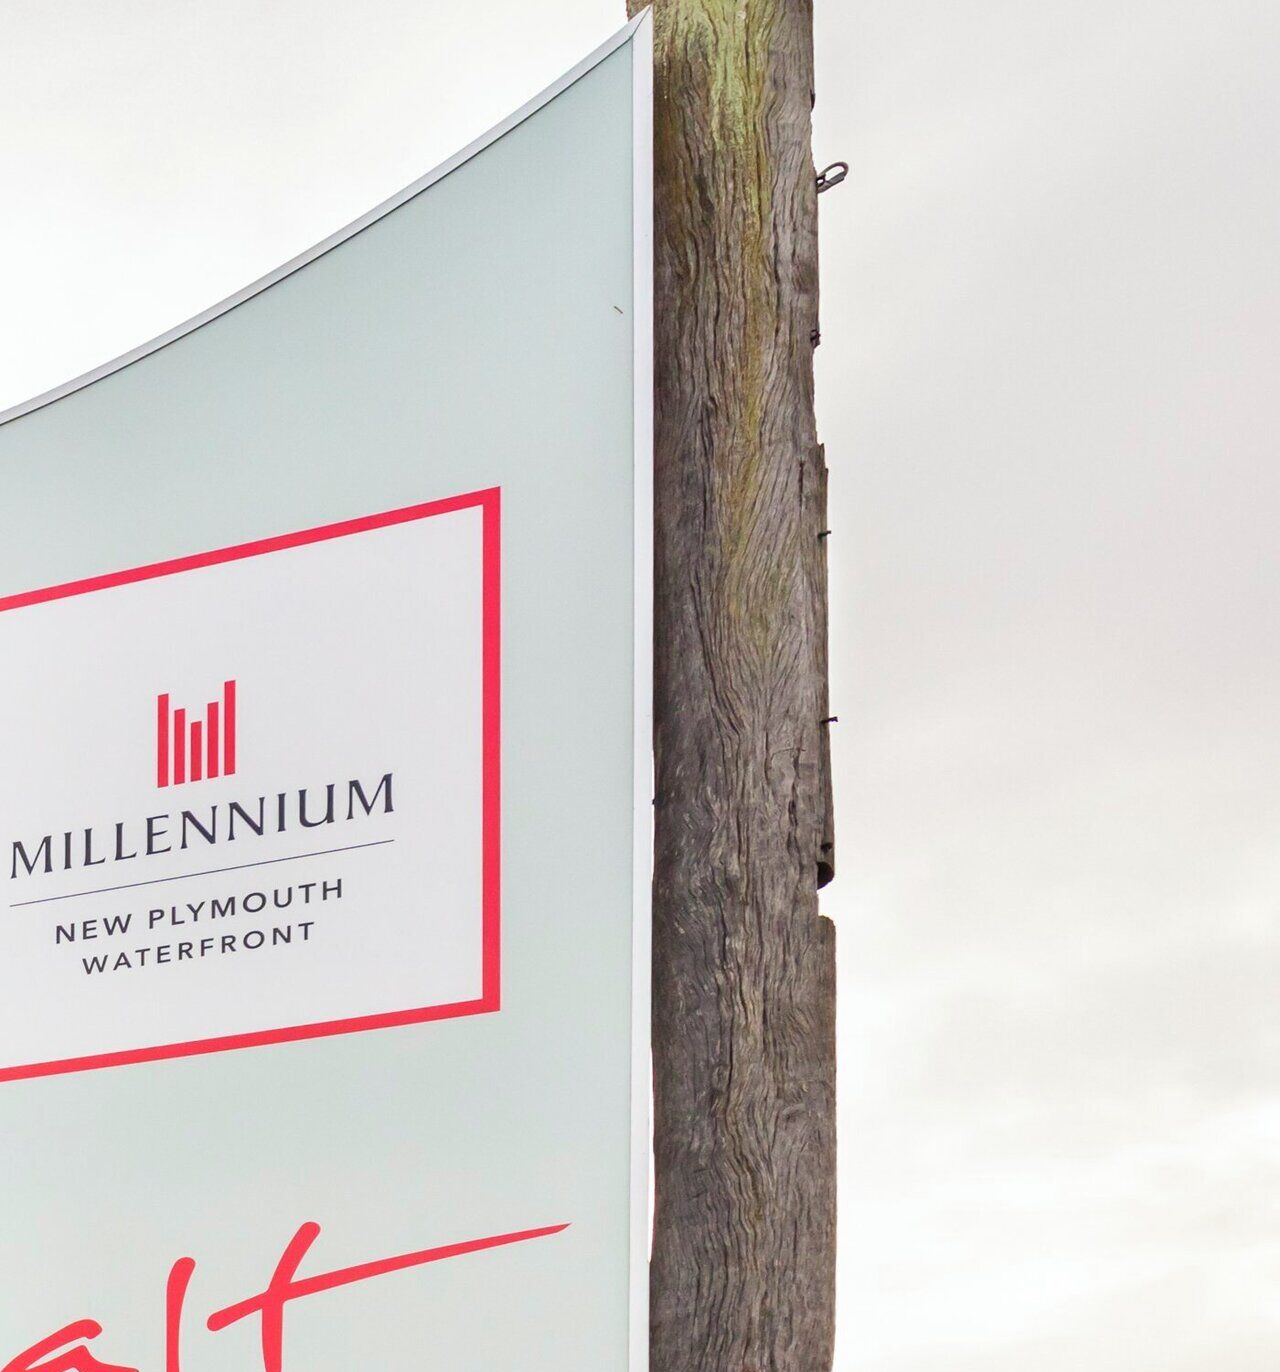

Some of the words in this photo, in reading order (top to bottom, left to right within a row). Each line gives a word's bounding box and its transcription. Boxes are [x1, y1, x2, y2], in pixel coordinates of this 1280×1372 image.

[10, 773, 394, 879] MILLENNIUM
[56, 913, 132, 944] NEW
[149, 878, 343, 930] PLYMOUTH
[82, 921, 315, 976] WATERFRONT
